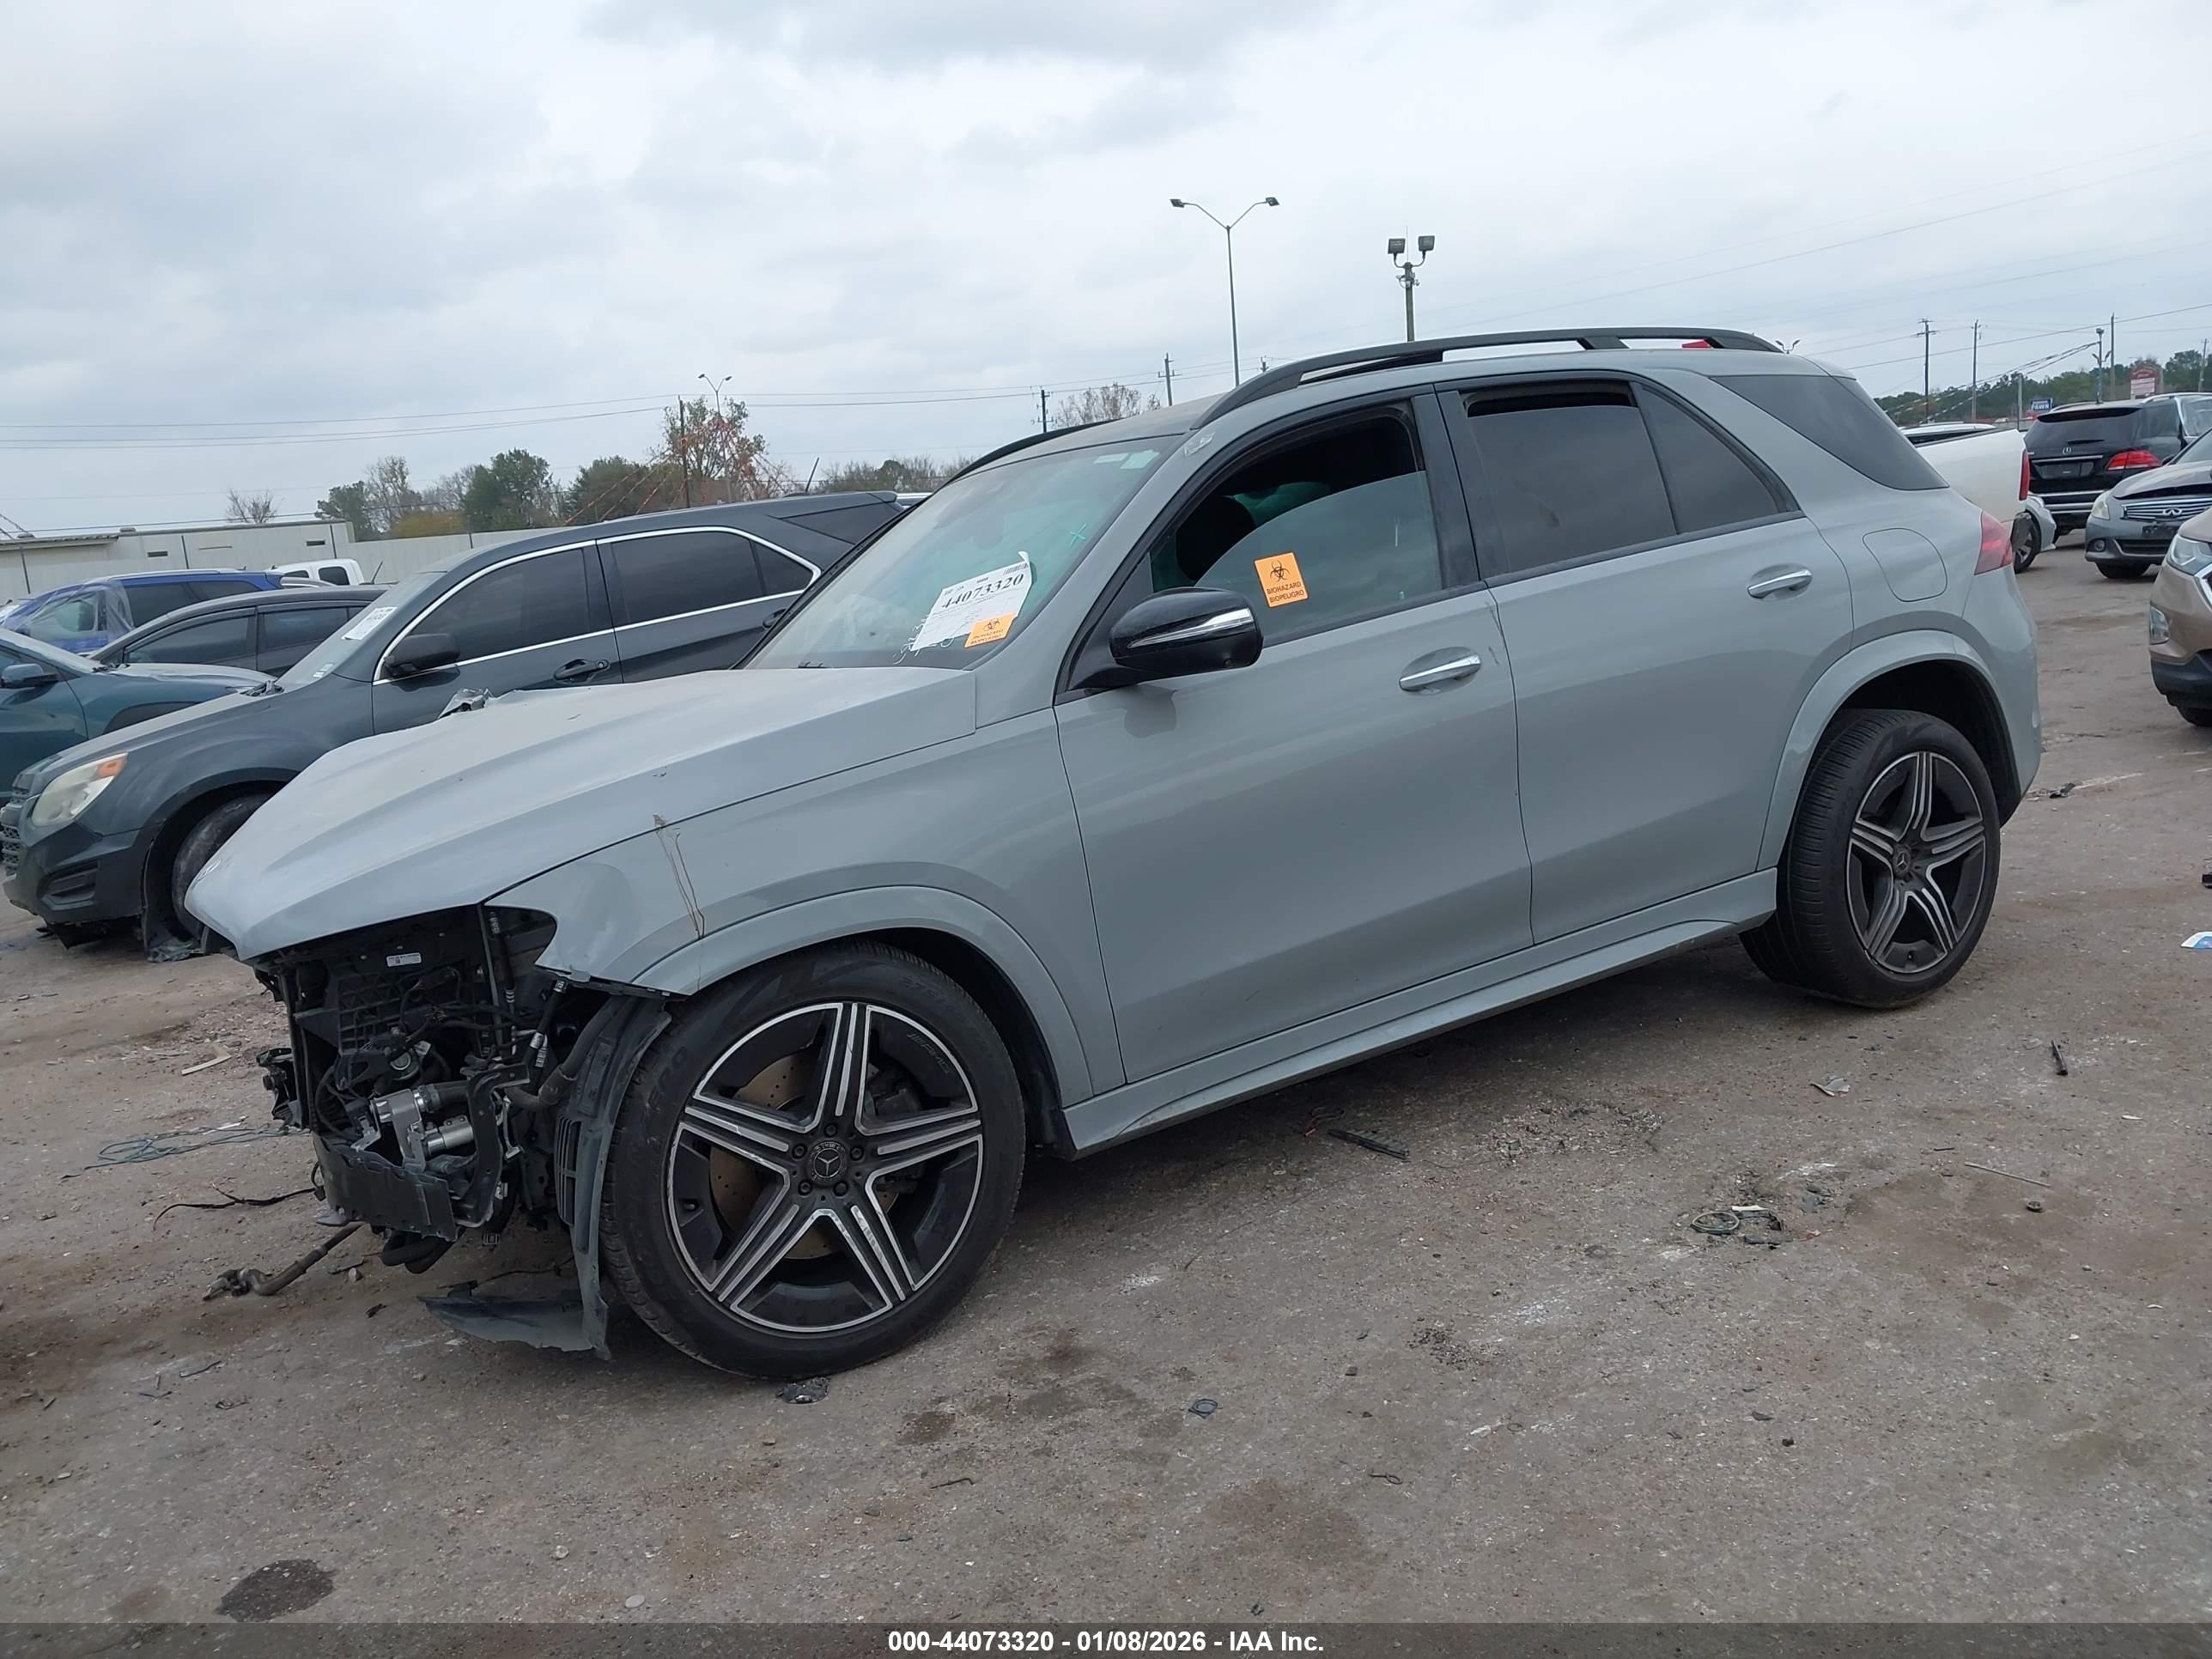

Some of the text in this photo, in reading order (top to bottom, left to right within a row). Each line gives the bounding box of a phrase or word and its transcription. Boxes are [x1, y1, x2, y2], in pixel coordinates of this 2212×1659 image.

[942, 574, 1024, 608] 44073320
[1267, 581, 1301, 594] BIOHAZARD
[1269, 589, 1304, 603] BIOPELIGRO
